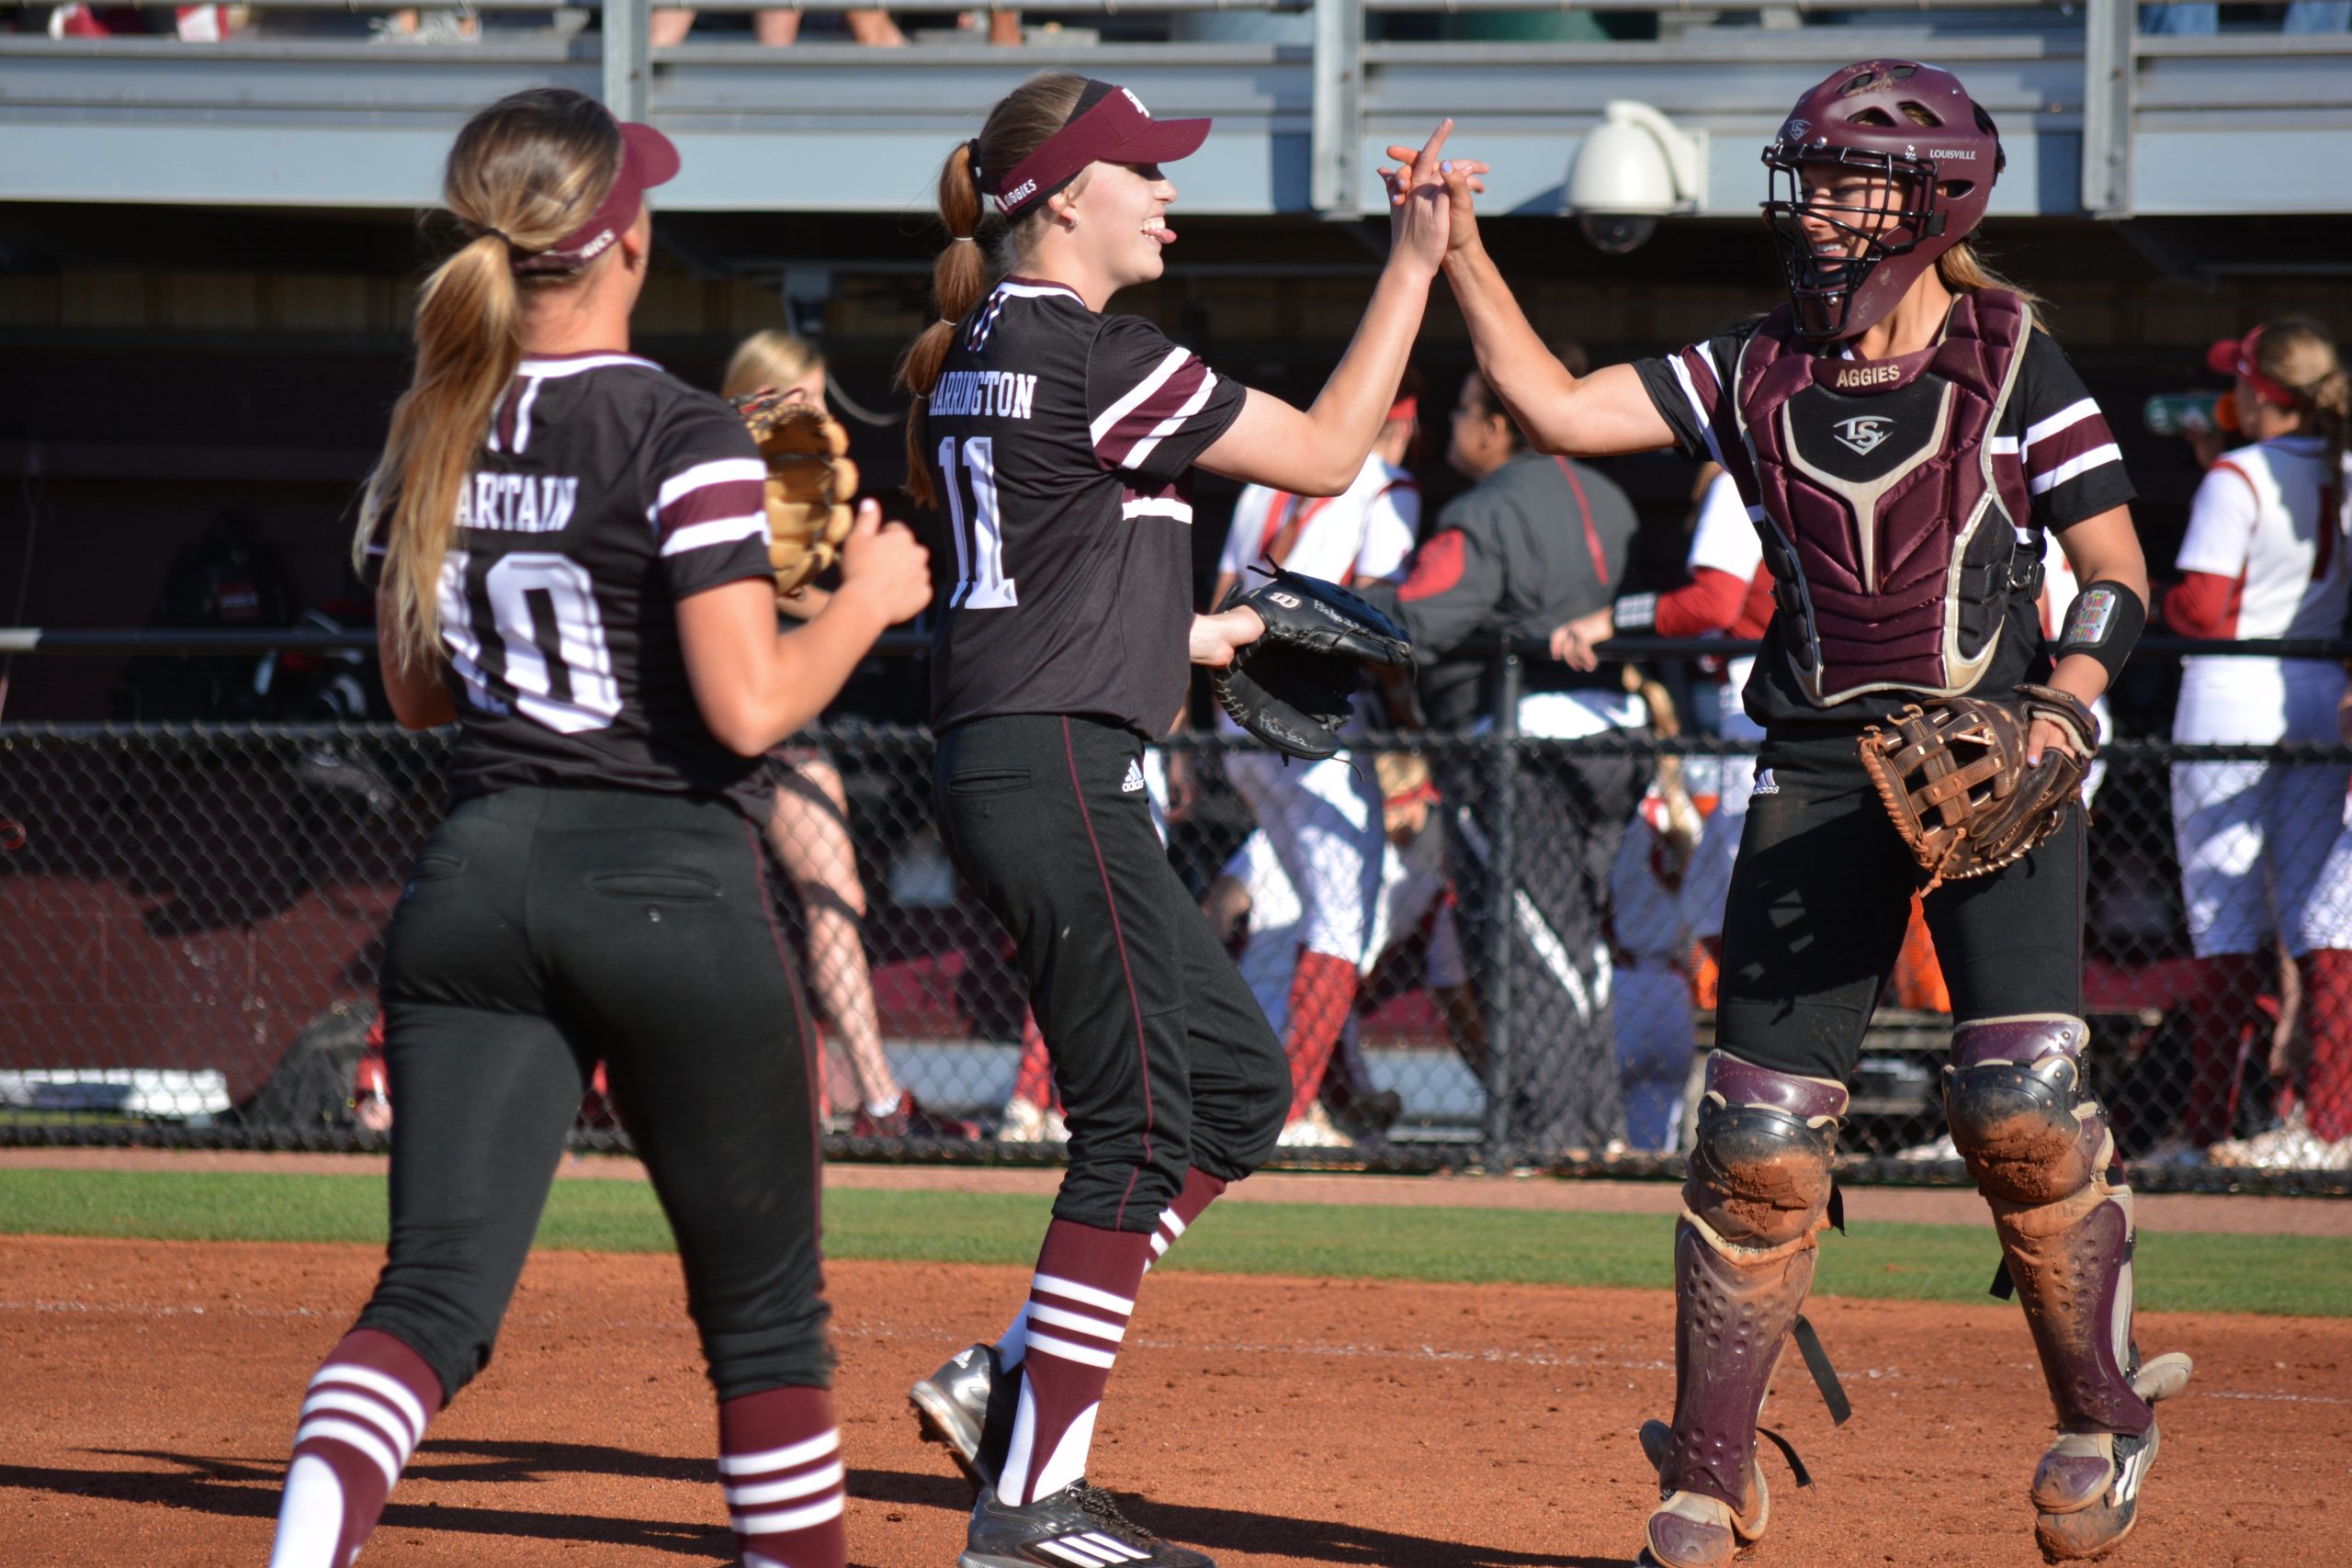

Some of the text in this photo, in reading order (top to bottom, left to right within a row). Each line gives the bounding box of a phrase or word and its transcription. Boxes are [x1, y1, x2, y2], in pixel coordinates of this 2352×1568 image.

[1929, 149, 1976, 161] LOUISVILLE
[1836, 365, 1901, 388] AGGIES
[454, 470, 579, 533] ARTAIN
[938, 435, 1019, 610] 11
[435, 549, 624, 734] 10
